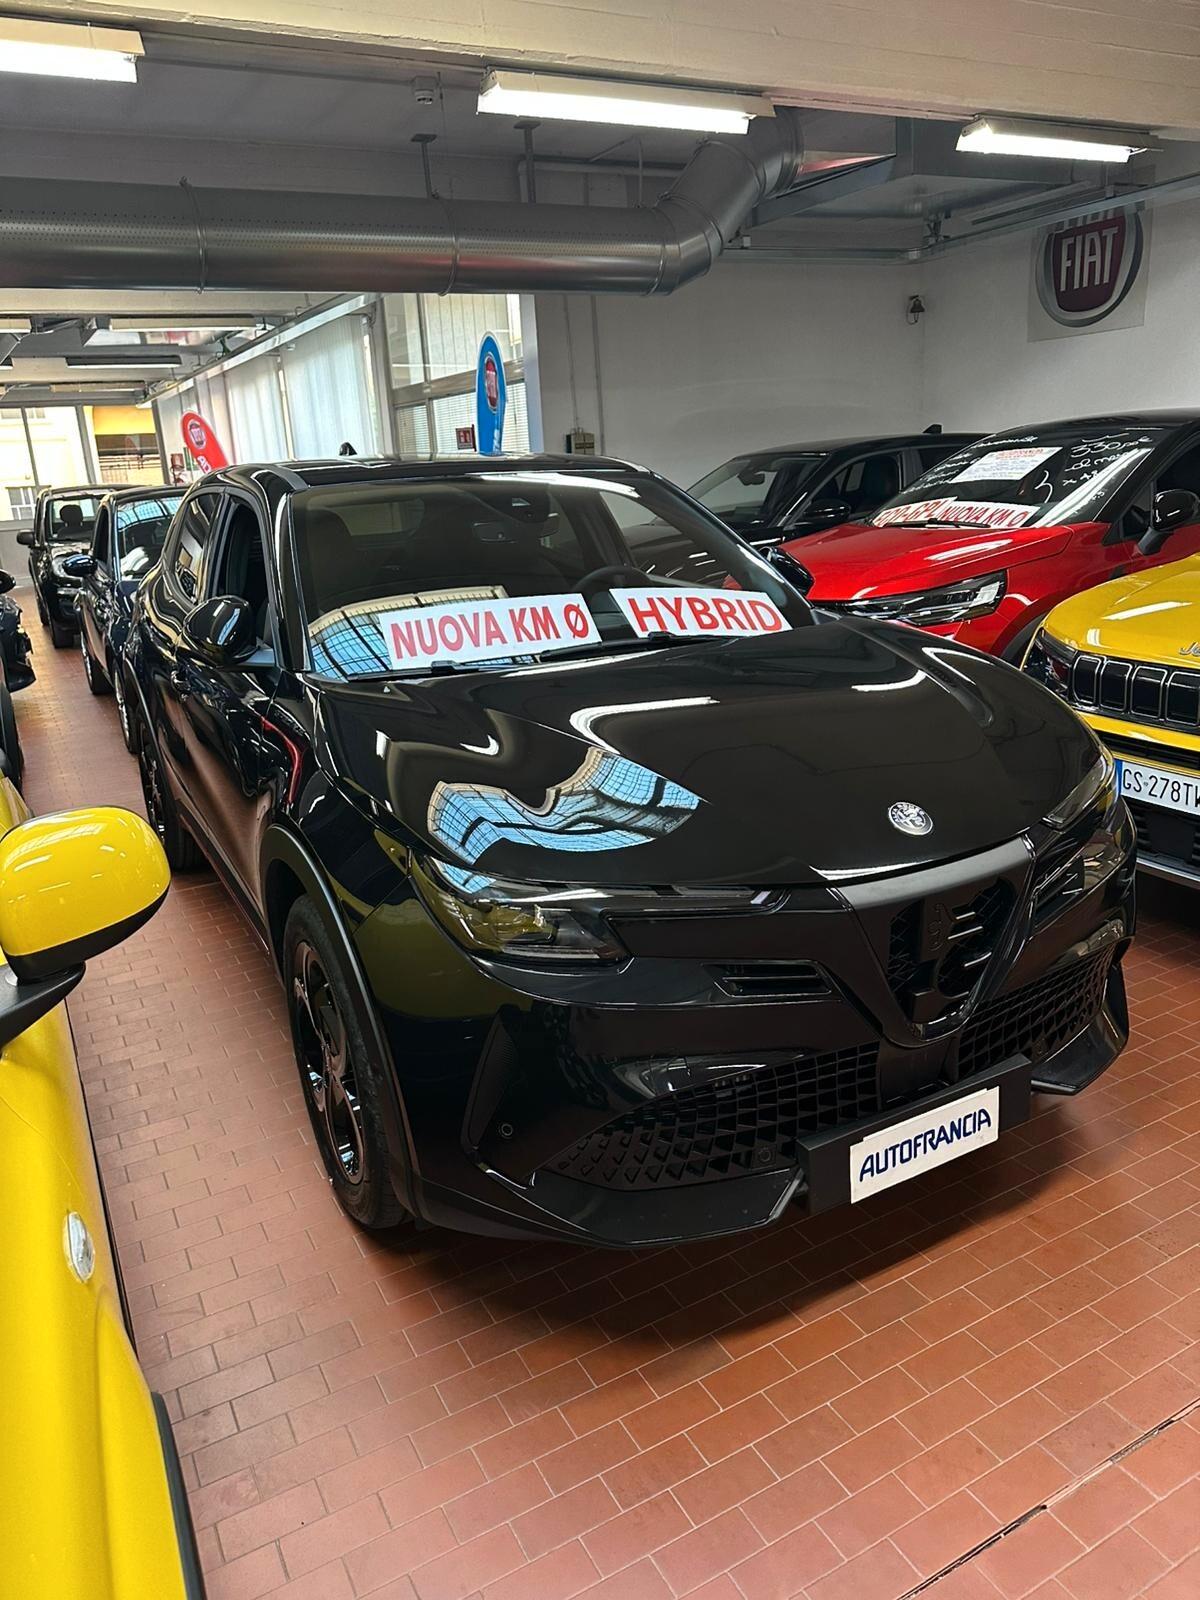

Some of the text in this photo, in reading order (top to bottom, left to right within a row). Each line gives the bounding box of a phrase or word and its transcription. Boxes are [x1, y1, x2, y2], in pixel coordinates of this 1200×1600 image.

[1060, 227, 1119, 292] FIAT
[937, 505, 990, 523] NUOVA
[982, 507, 1015, 526] KM
[390, 610, 508, 660] NUOVA
[508, 605, 562, 643] KM
[627, 597, 783, 633] HYBRID
[859, 1108, 992, 1182] AUTOFRANCIA
